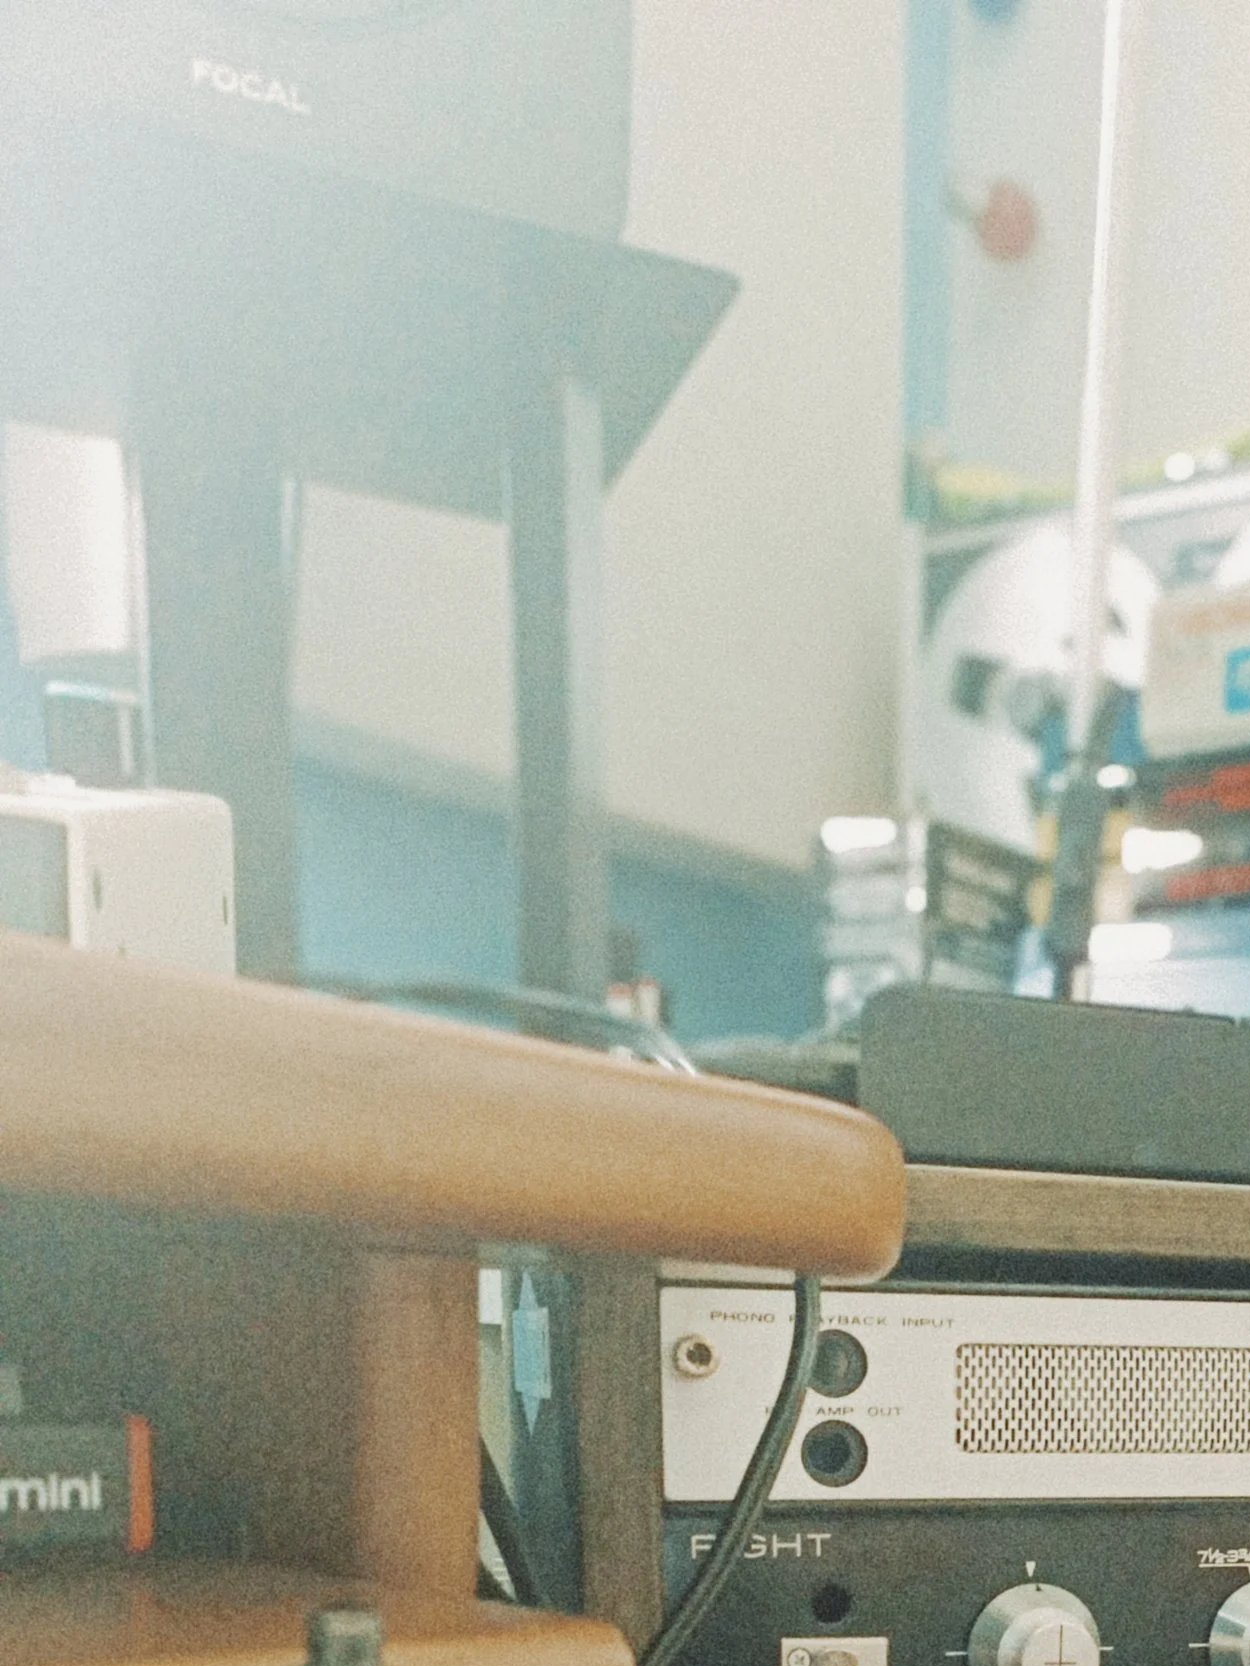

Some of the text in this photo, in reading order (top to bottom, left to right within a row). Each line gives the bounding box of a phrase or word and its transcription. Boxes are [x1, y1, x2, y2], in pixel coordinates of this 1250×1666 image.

[192, 59, 311, 113] FOCAL
[709, 1310, 955, 1329] PHONO PYBACK INPUT
[815, 1406, 903, 1418] AMP OUT
[0, 1470, 102, 1513] mini
[690, 1532, 832, 1559] RGHT
